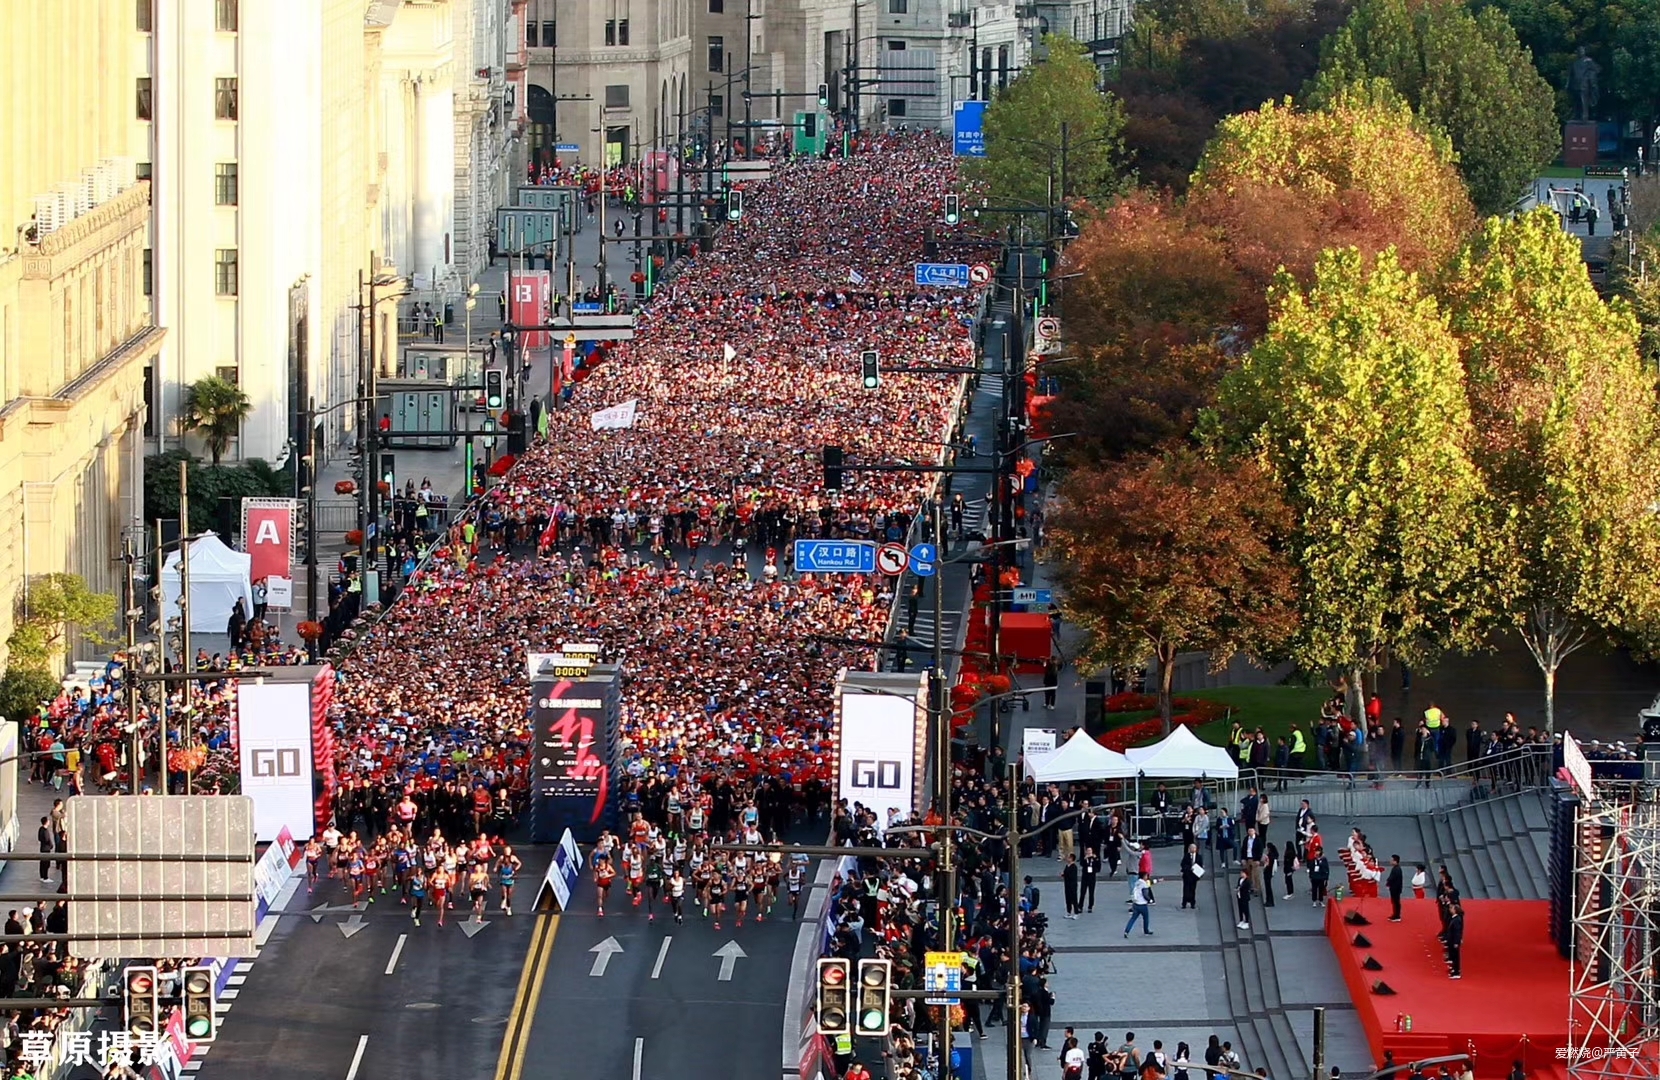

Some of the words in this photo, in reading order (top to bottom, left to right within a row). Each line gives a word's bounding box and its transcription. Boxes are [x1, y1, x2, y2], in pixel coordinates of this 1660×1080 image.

[515, 285, 532, 302] B
[254, 519, 281, 545] A
[818, 546, 857, 558] 汉口路
[252, 748, 301, 777] GO
[851, 759, 902, 789] GO
